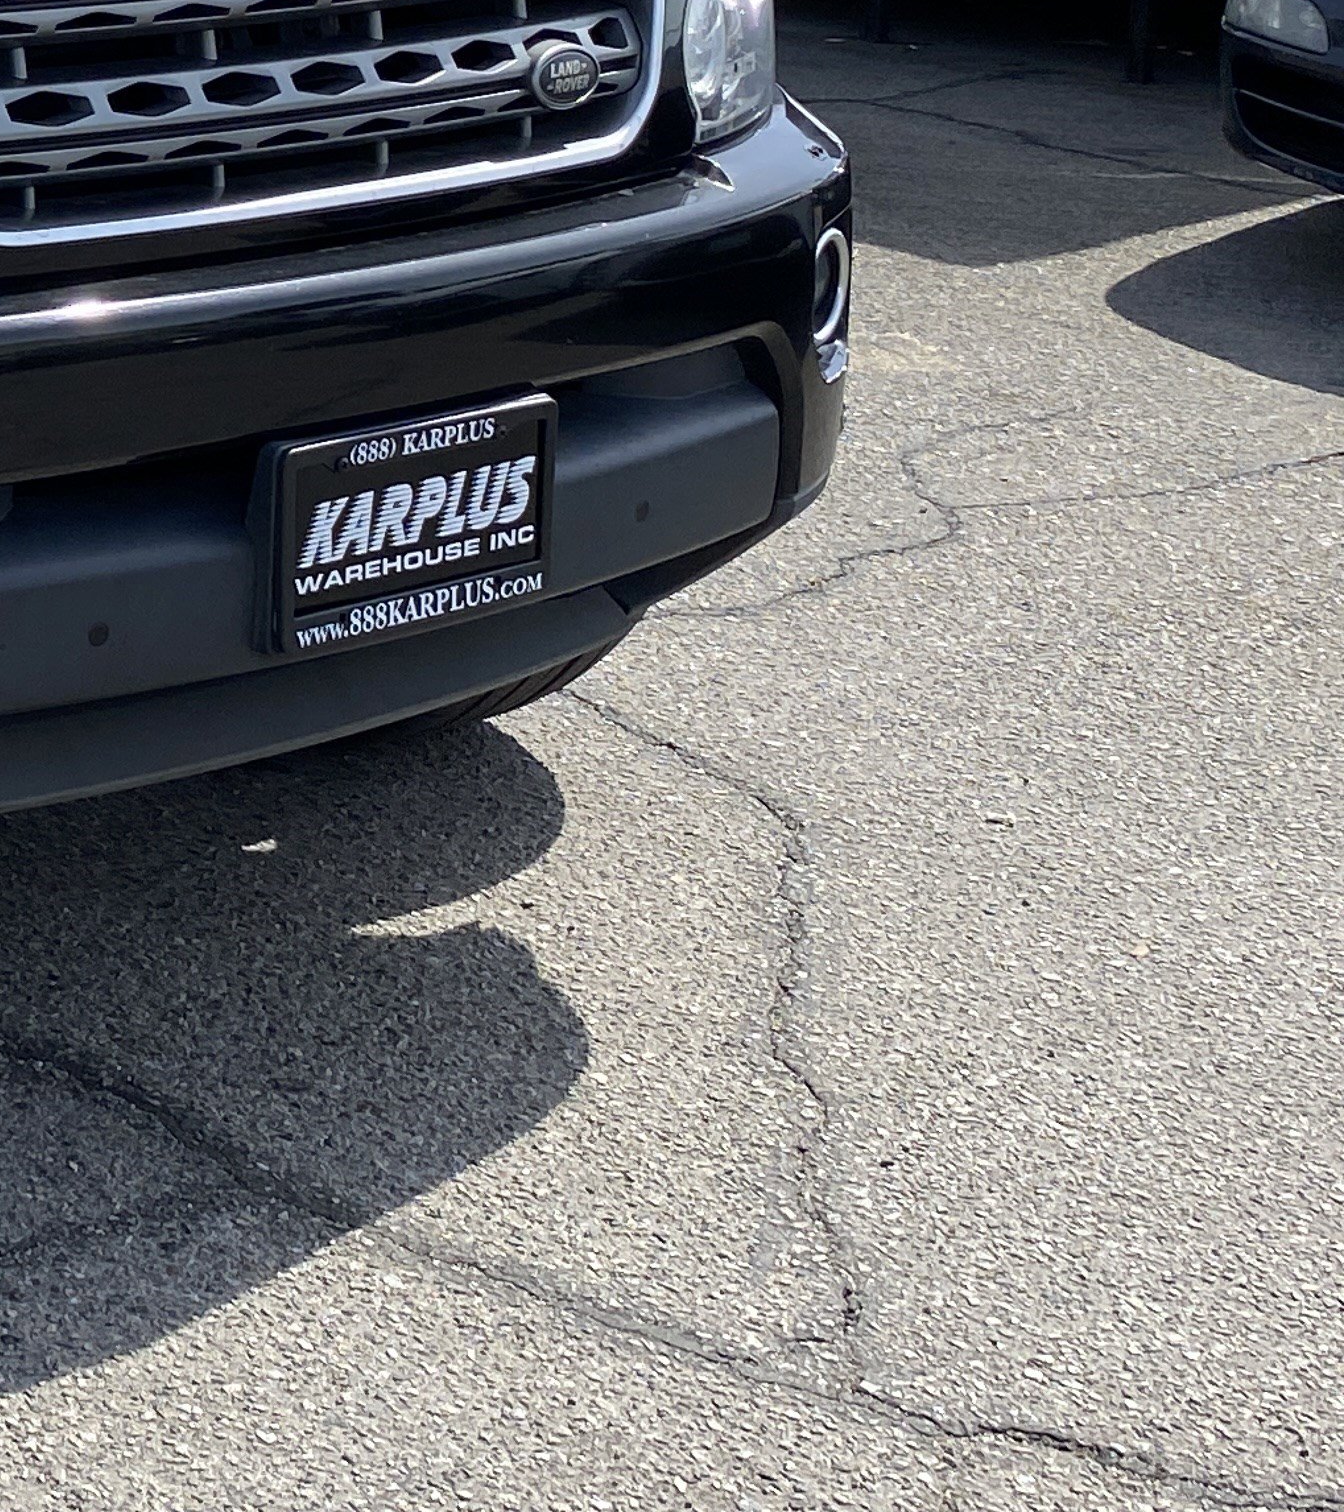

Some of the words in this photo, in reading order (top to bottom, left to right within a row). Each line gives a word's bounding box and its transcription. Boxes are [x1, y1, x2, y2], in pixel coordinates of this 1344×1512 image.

[349, 437, 397, 466] (888)
[402, 417, 496, 457] KARPLUS
[296, 455, 536, 570] KARPLUS
[294, 538, 481, 596] WAREHOUSE
[489, 524, 535, 552] INC
